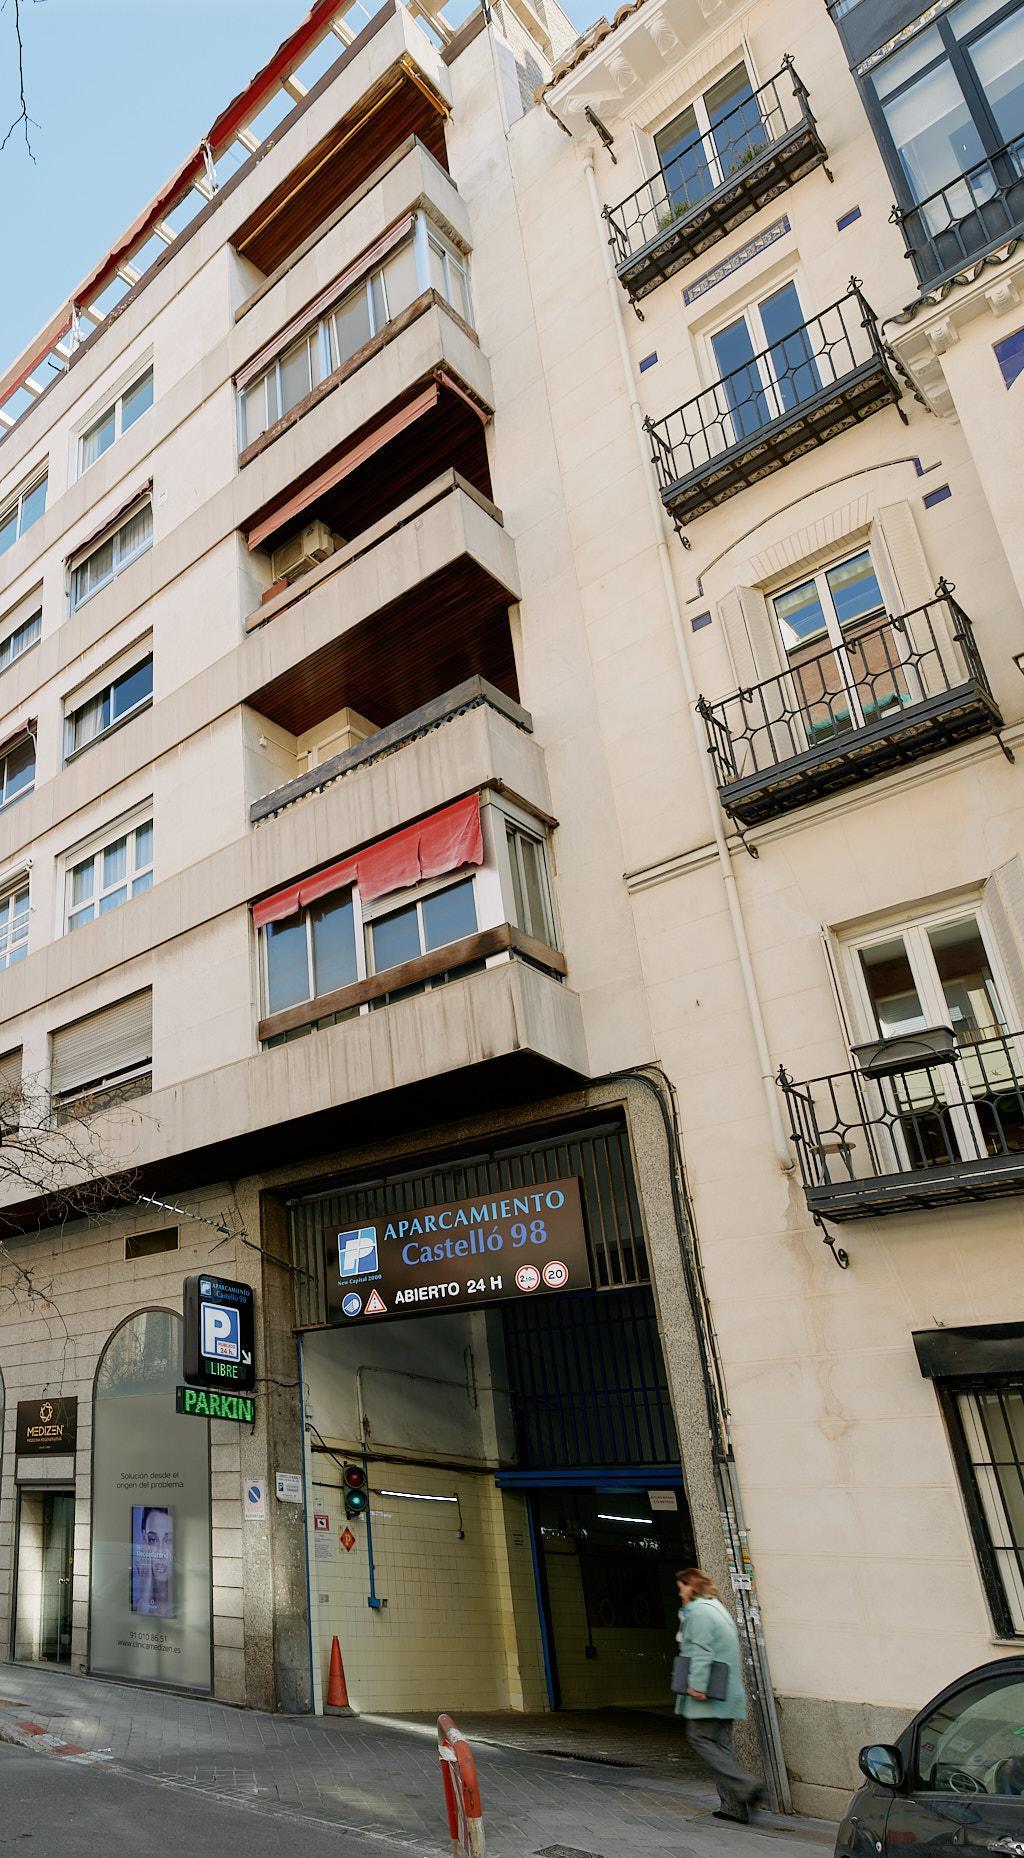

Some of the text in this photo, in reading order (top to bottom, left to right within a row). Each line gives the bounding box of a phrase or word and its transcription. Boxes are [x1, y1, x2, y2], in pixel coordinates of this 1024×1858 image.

[383, 1190, 565, 1241] APARCAMIENTO
[401, 1219, 547, 1266] Castelló 98
[548, 1269, 563, 1280] 20
[212, 1283, 250, 1297] APARCAMIENTO
[395, 1275, 503, 1305] ABIERTO 24 H
[204, 1306, 232, 1354] P
[210, 1361, 239, 1379] LIBRE
[184, 1389, 253, 1422] PARKIN
[26, 1425, 64, 1437] MEDIZEN
[120, 1472, 149, 1480] Solución
[116, 1482, 137, 1490] origen
[150, 1481, 184, 1490] problema
